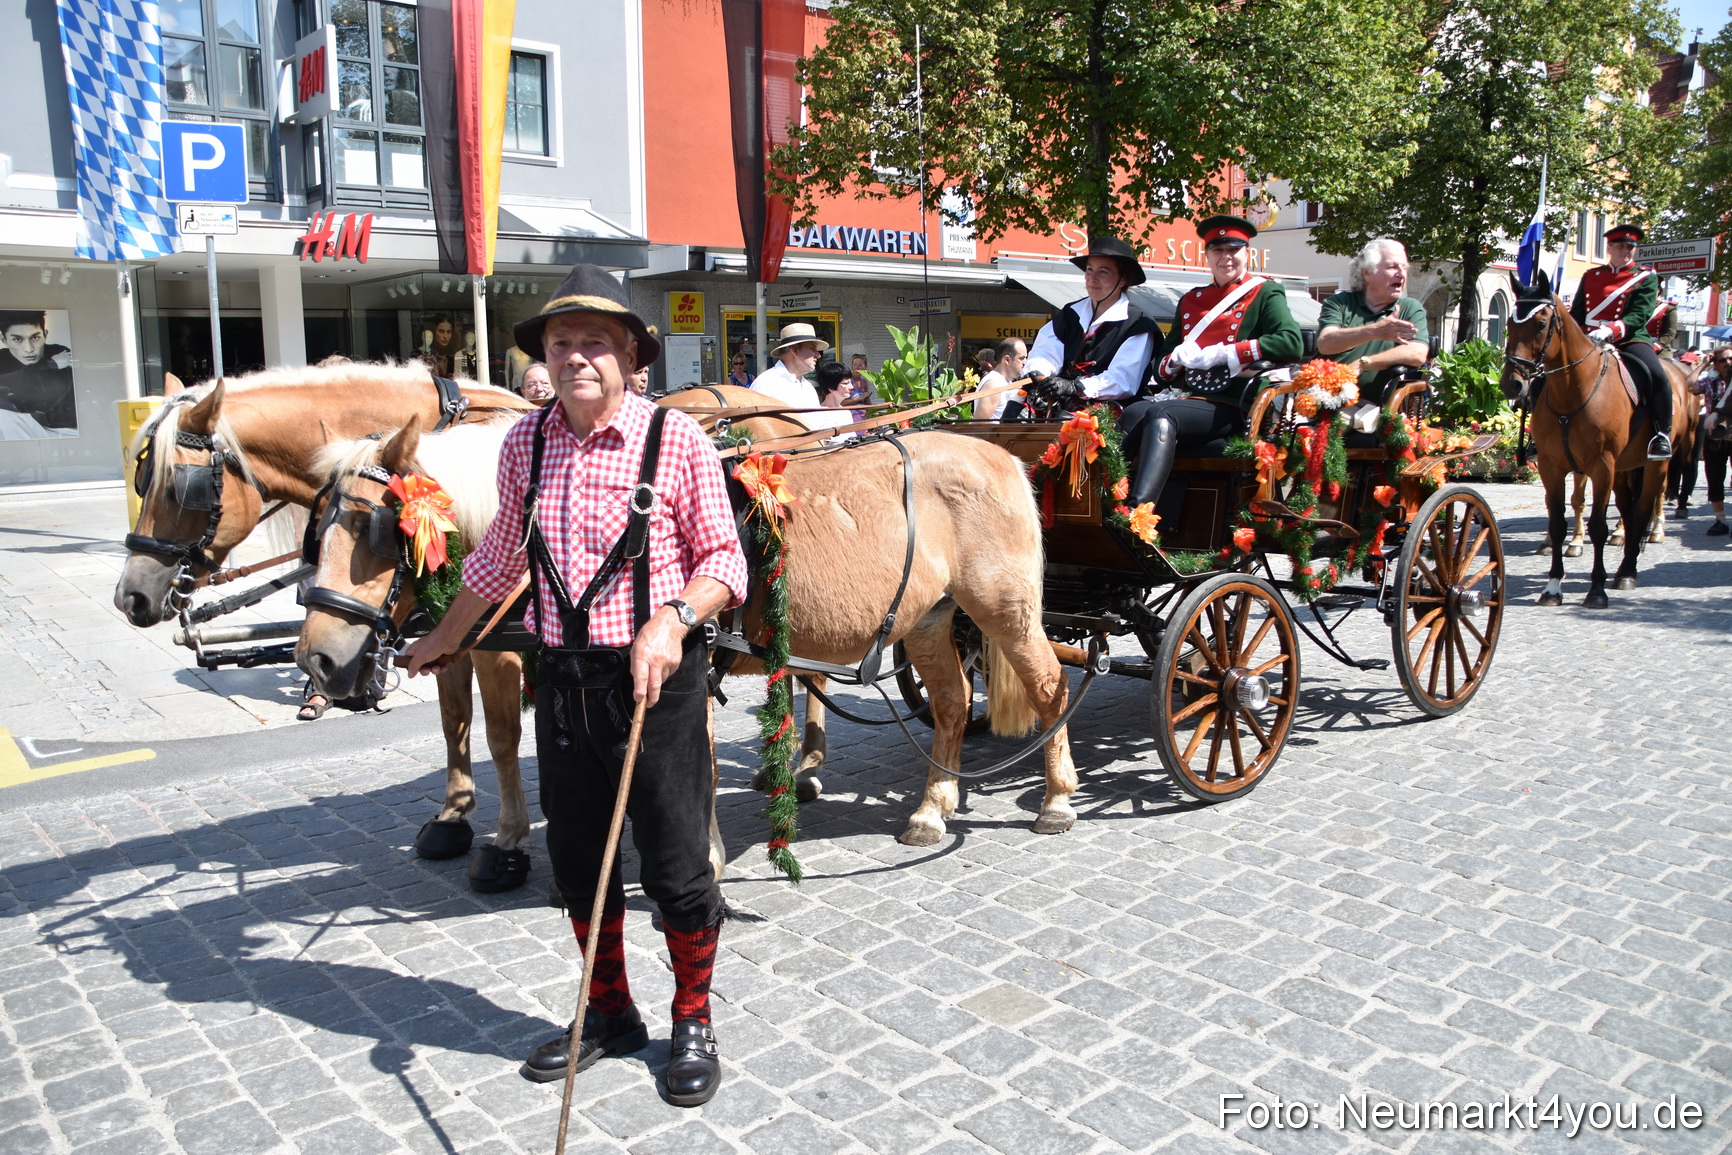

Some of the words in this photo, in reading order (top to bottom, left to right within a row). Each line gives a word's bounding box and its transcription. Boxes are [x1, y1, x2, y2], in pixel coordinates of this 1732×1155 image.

[298, 46, 325, 103] H&M
[181, 132, 226, 192] P
[299, 211, 374, 264] H&M
[1638, 245, 1696, 258] Parkleitsystem
[1657, 261, 1696, 271] Rosengasse
[782, 299, 795, 308] NZ
[673, 314, 701, 324] LOTTO
